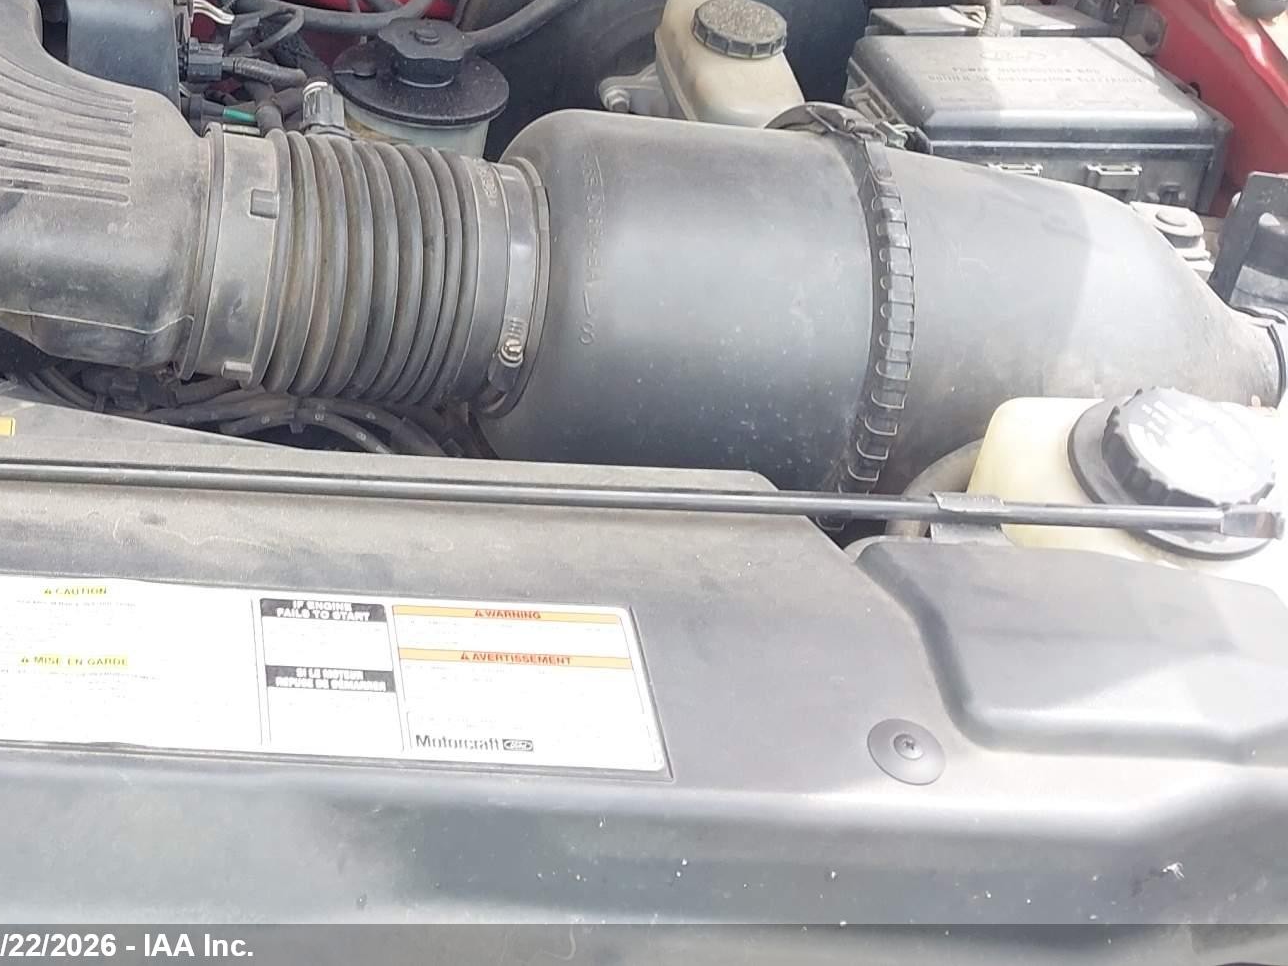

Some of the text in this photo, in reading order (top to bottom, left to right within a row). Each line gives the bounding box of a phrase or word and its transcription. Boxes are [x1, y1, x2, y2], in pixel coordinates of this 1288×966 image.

[292, 600, 353, 613] IF ENGINE
[276, 607, 371, 622] FAILS TO START
[486, 609, 542, 620] WARNING
[34, 656, 59, 665] MISE
[87, 658, 128, 666] GARDE
[472, 652, 572, 665] AVERTISSEMENT
[415, 734, 500, 751] Motorcraft
